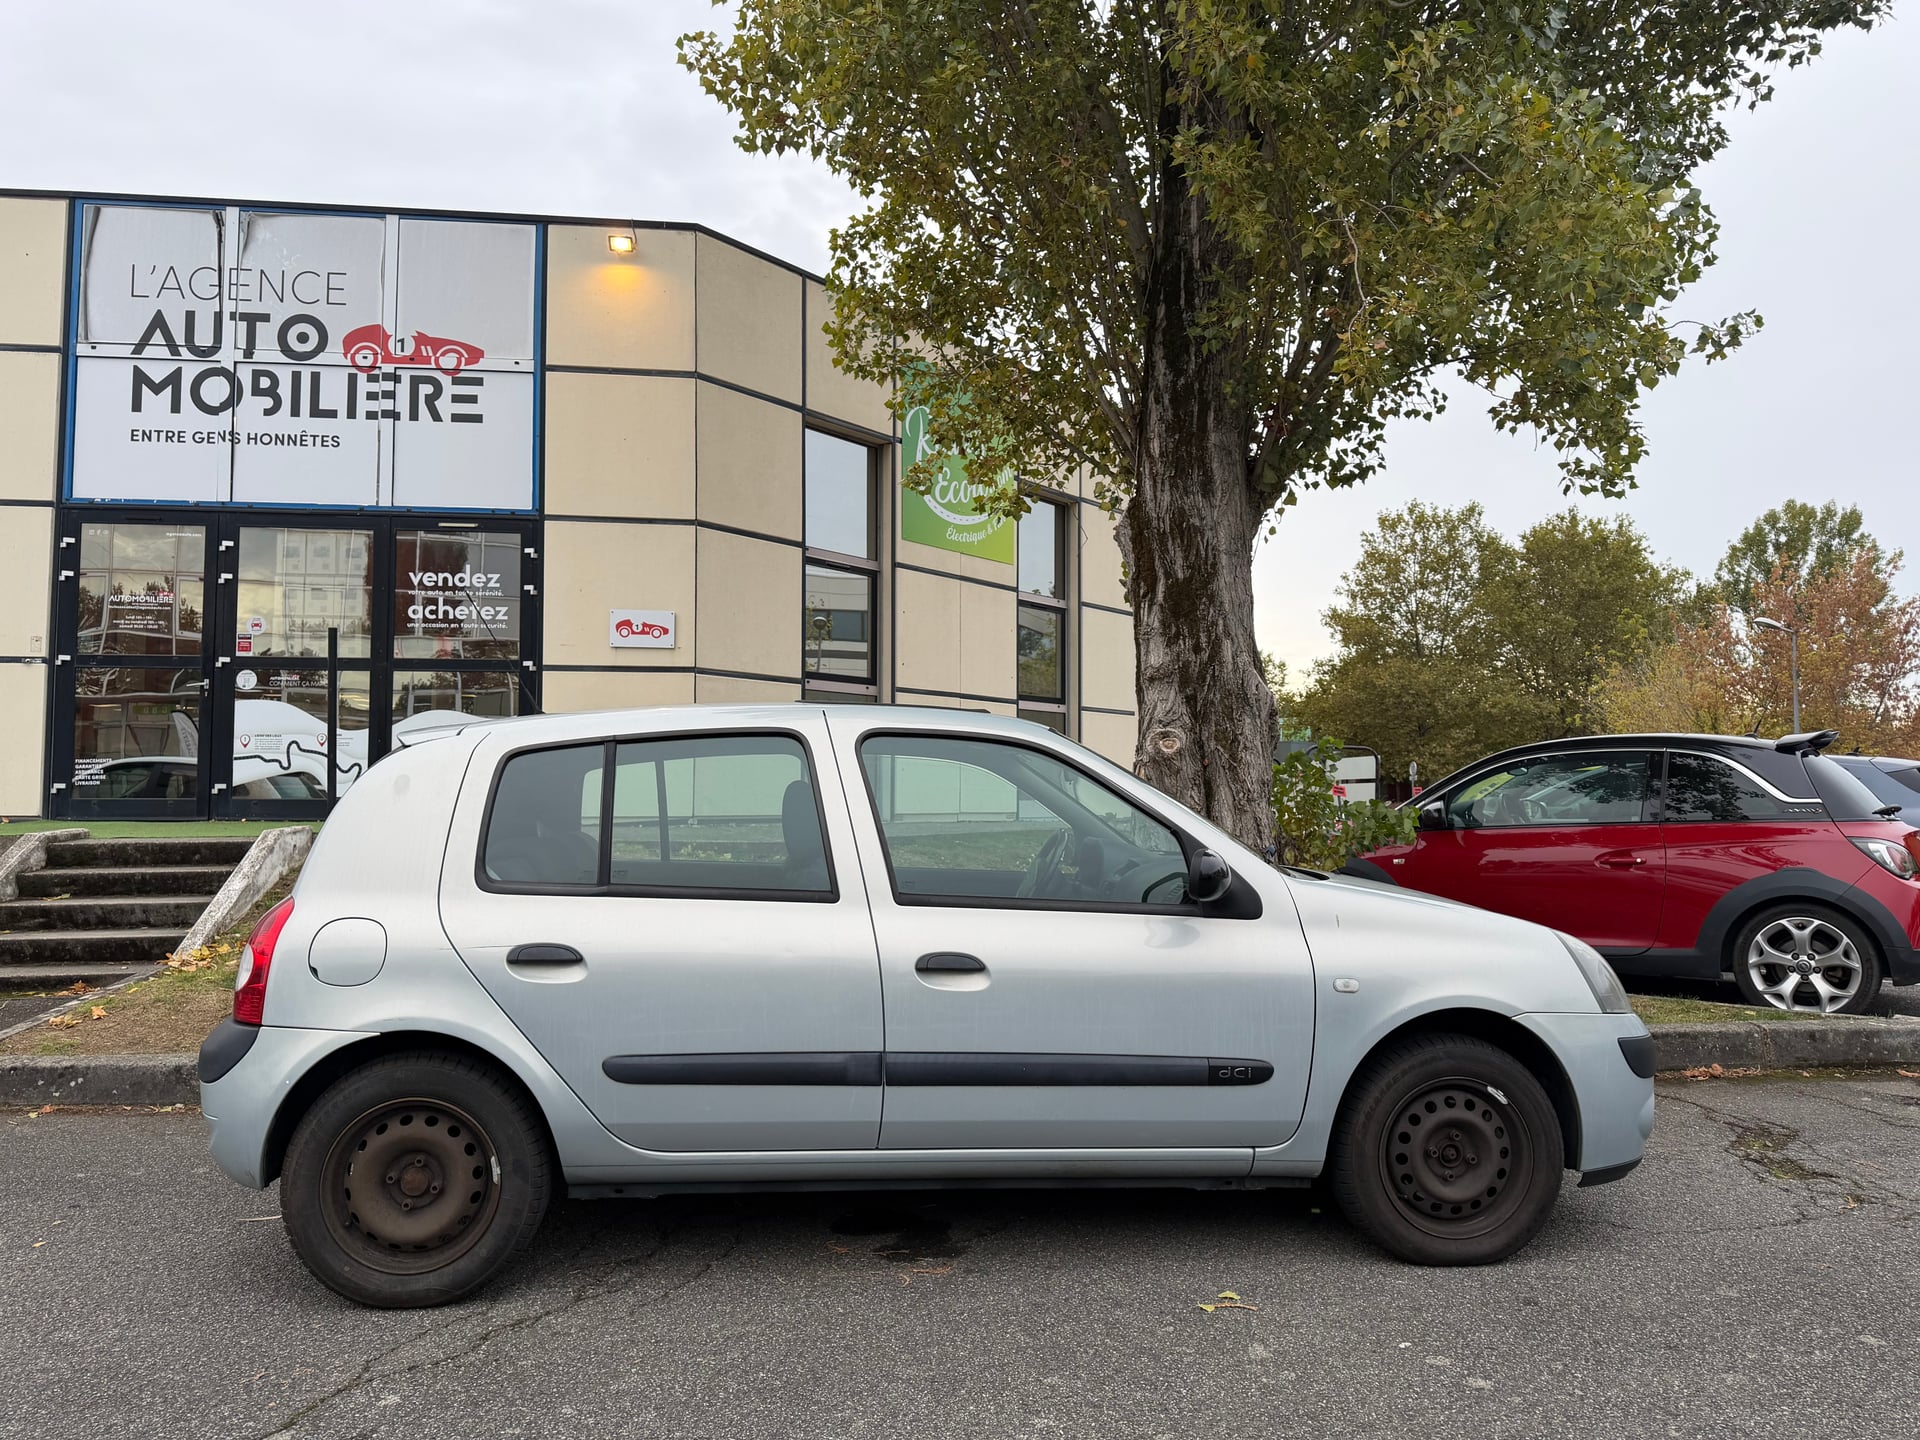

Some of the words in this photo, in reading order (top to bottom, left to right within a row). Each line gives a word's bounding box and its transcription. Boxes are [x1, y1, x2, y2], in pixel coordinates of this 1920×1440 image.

[131, 263, 347, 306] L'AGENCE
[131, 308, 329, 362] AUTO
[130, 429, 187, 443] ENTRE
[192, 430, 241, 445] GENS
[246, 430, 341, 448] HONNÊTES
[408, 564, 501, 588] vendez
[407, 597, 509, 620] achetez
[1218, 1066, 1252, 1079] dCi
